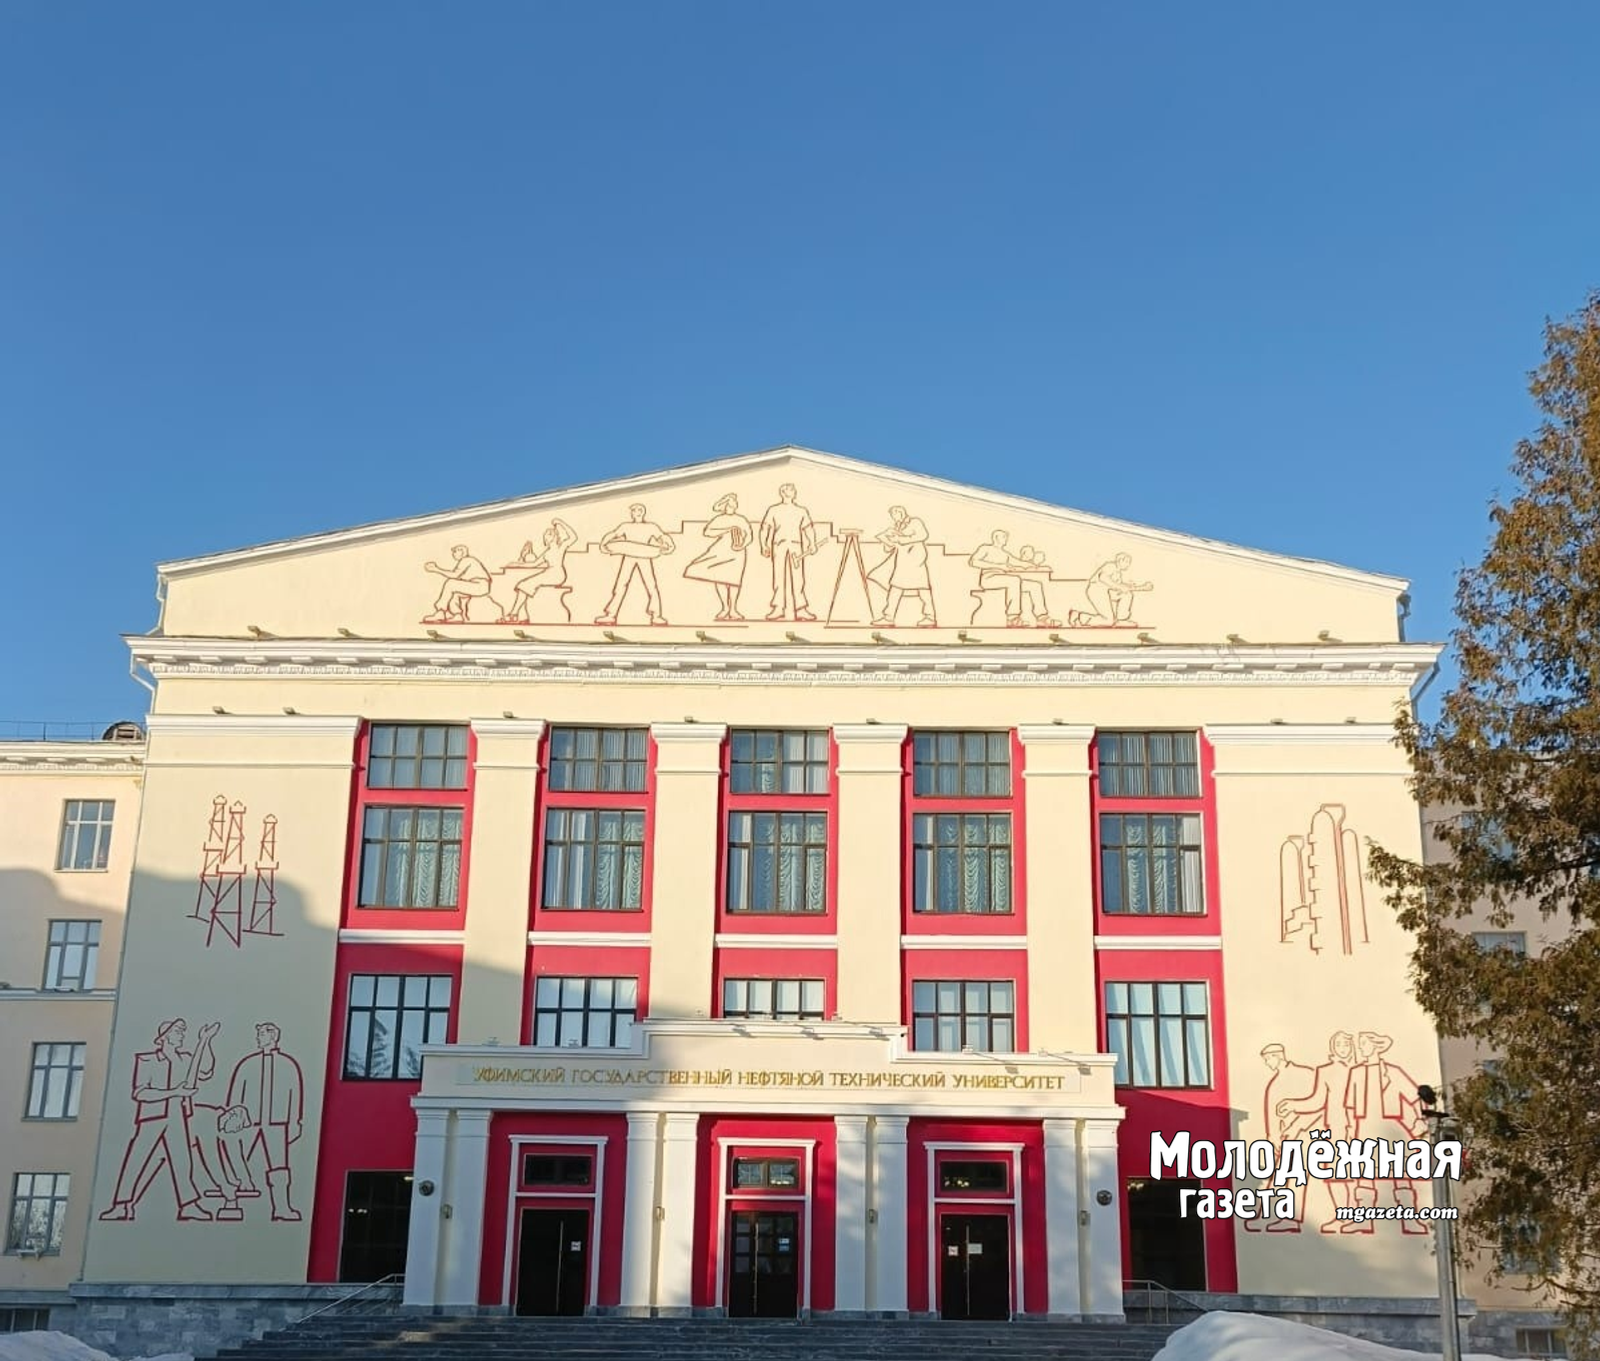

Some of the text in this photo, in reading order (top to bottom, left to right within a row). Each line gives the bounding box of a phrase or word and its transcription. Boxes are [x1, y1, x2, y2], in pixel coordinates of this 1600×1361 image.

[473, 1065, 1066, 1091] УФИМСКИЙ ГОСУДАРСТВЕННЫЙ НЕФТЯНОЙ ТЕХНИЧЕСКИЙ УНИВЕРСИТЕТ
